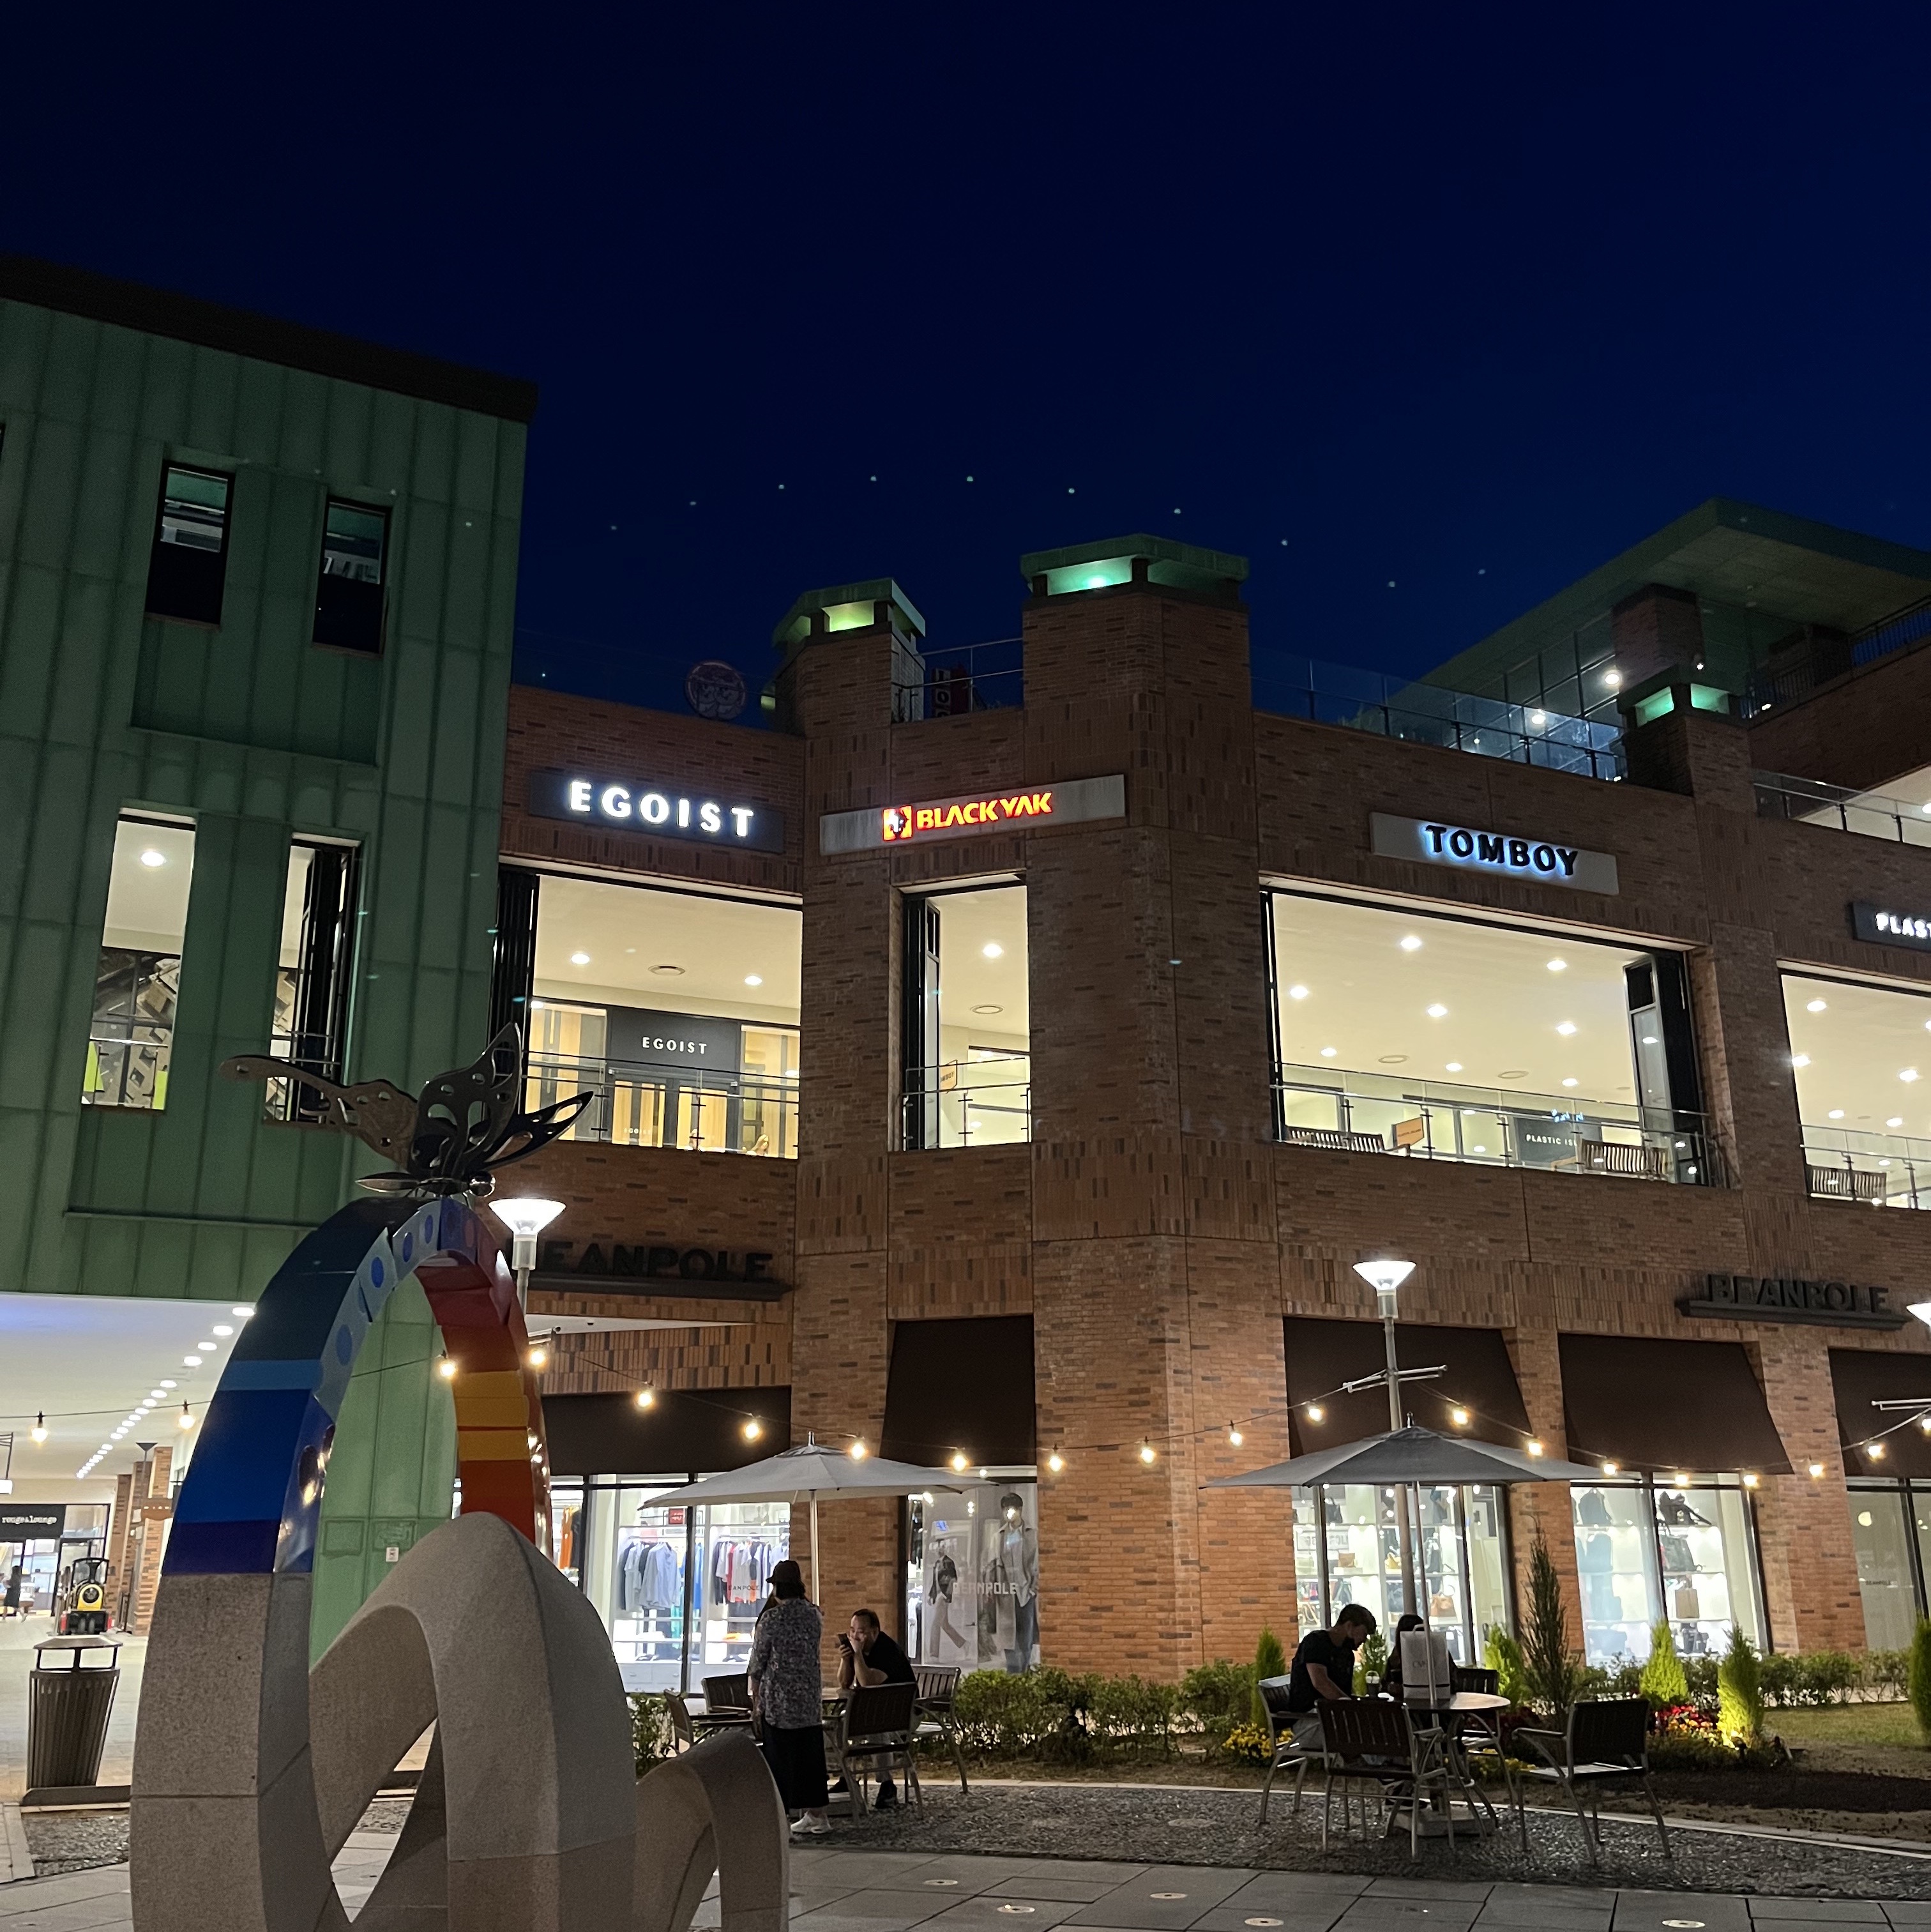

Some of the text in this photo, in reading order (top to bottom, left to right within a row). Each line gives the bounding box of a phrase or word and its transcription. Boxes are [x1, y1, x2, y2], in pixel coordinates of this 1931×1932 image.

[570, 780, 754, 837] EGOIST
[1425, 825, 1578, 876] TOMBOY
[642, 1037, 707, 1054] EGOIST
[1526, 1134, 1561, 1145] PLASTIC
[542, 1241, 773, 1282] EANPOLE
[1708, 1274, 1891, 1314] BEANPOLE
